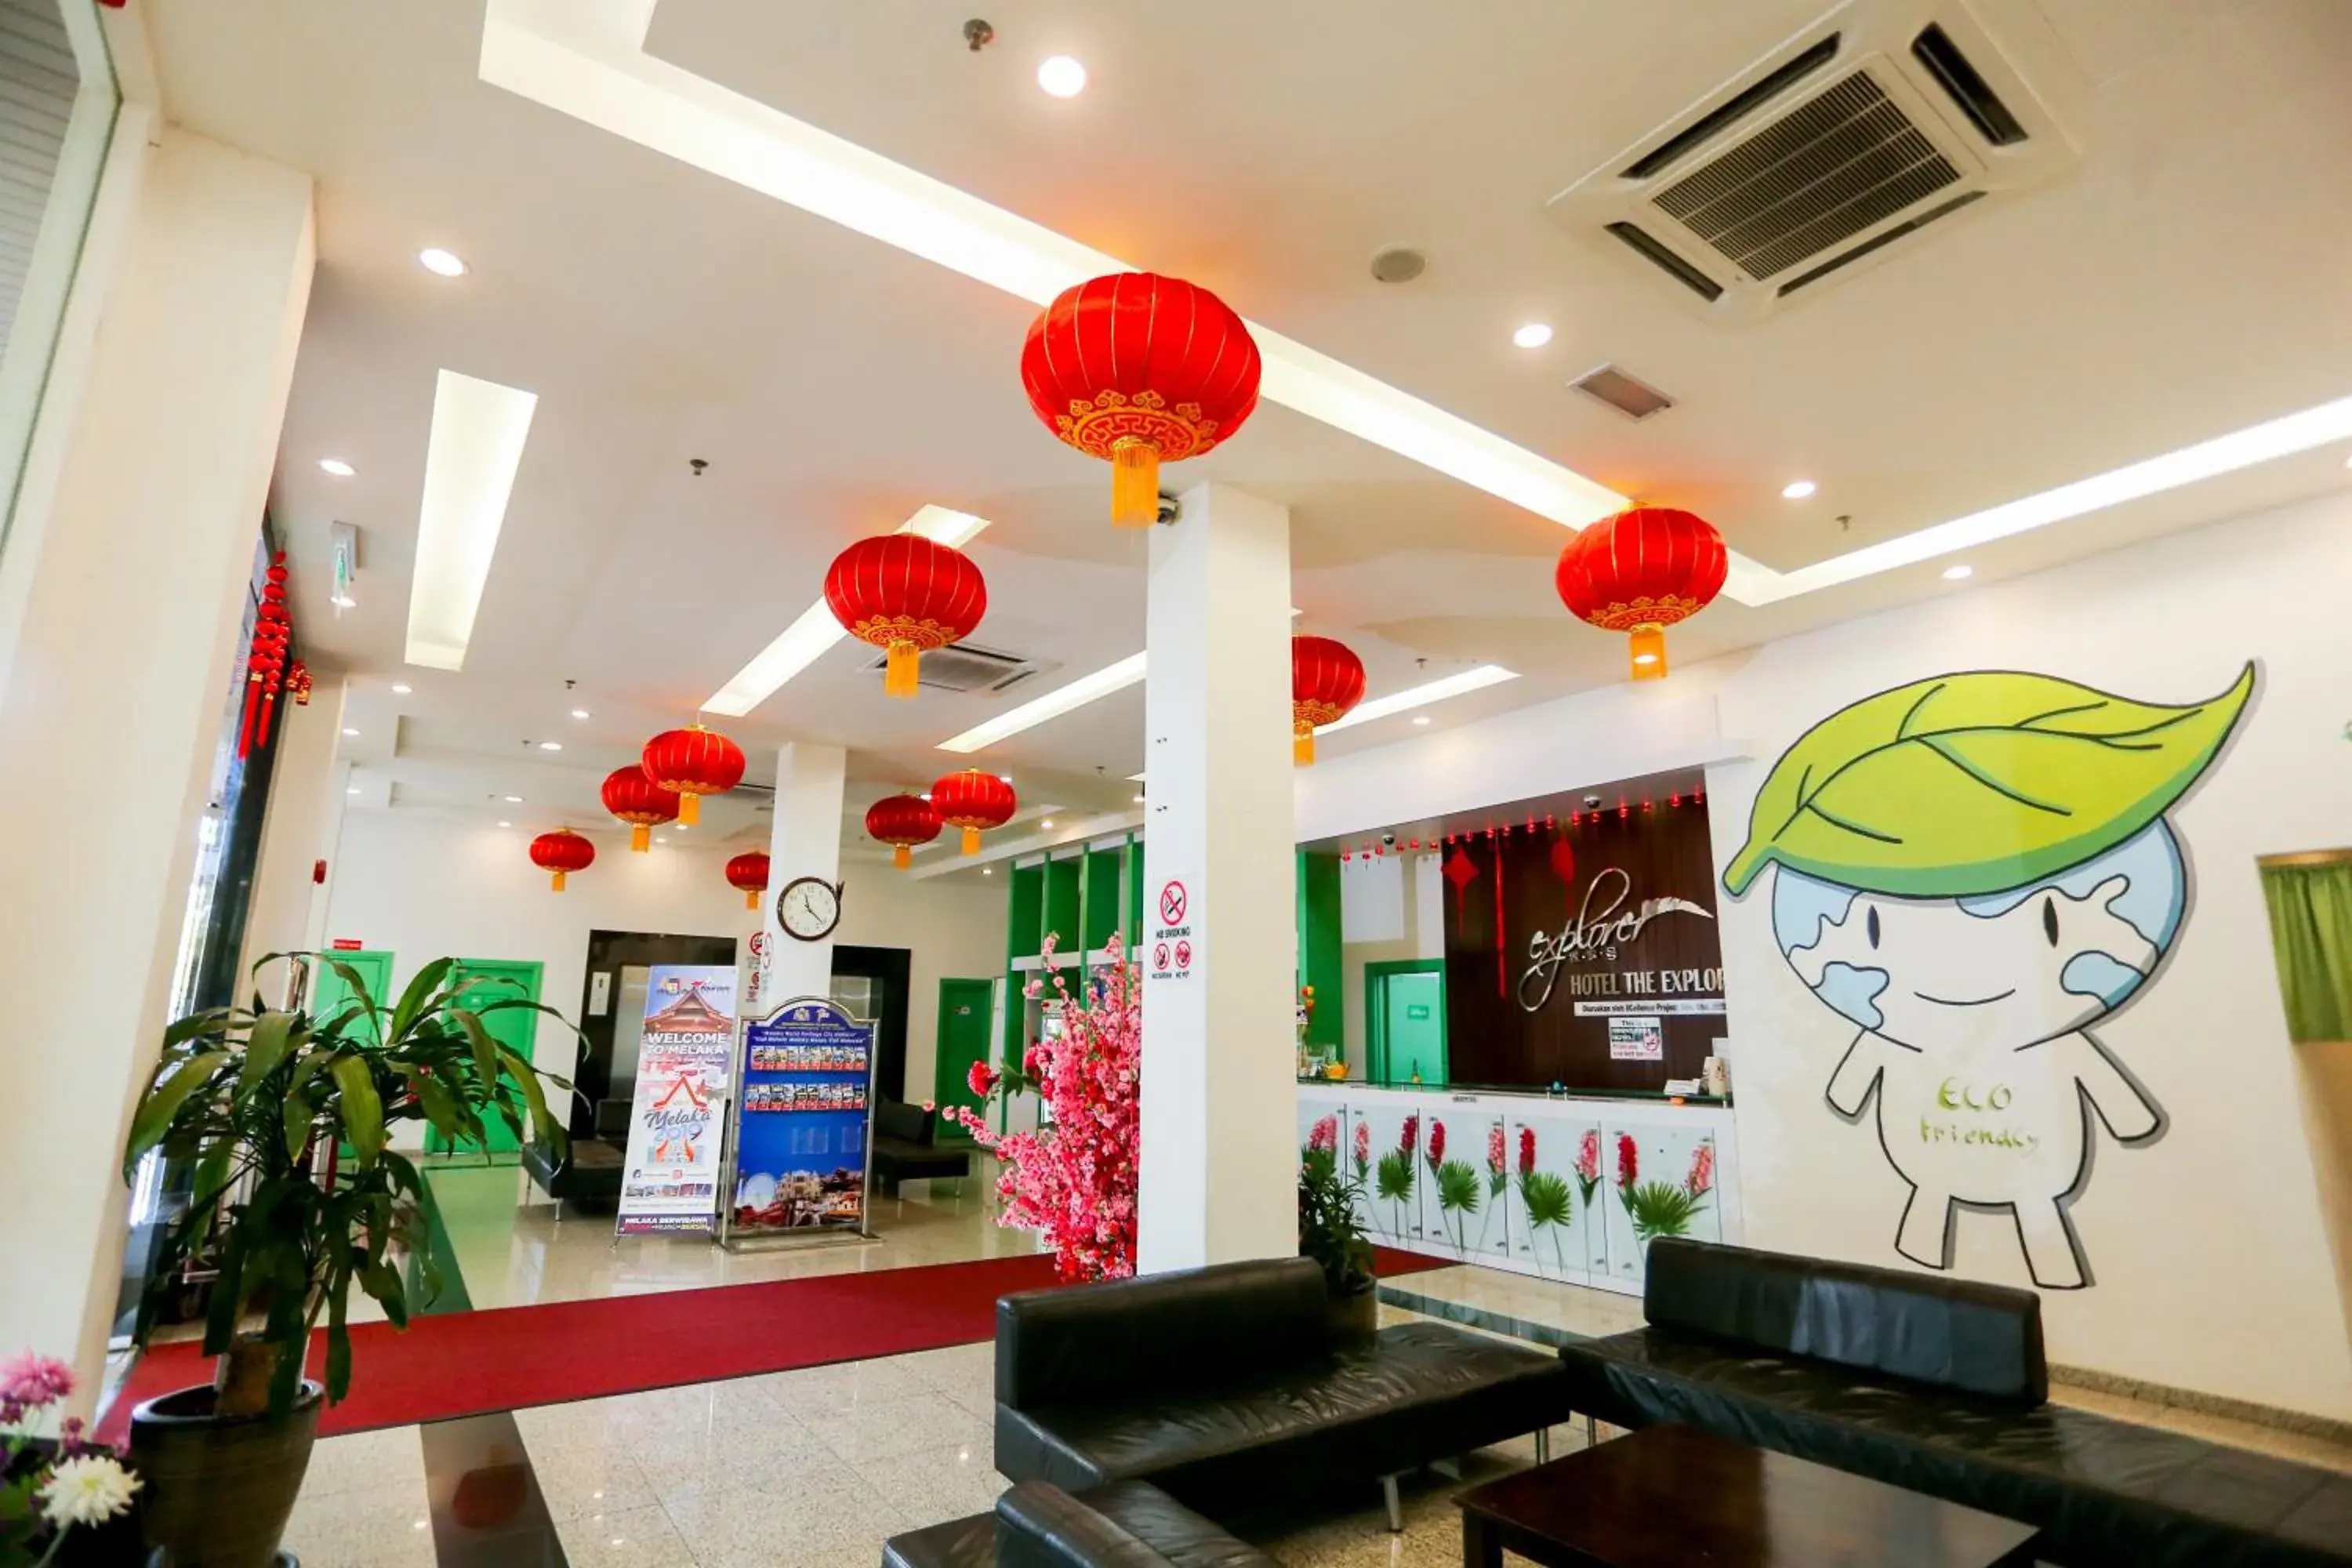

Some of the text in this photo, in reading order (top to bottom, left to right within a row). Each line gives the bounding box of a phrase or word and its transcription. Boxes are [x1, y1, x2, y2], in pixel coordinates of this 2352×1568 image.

[1570, 973, 1620, 996] HOTEL
[1623, 971, 1657, 993] THE
[648, 1033, 728, 1044] WELCOME
[648, 1045, 724, 1054] TO MELAKA
[644, 1107, 712, 1131] Melaka
